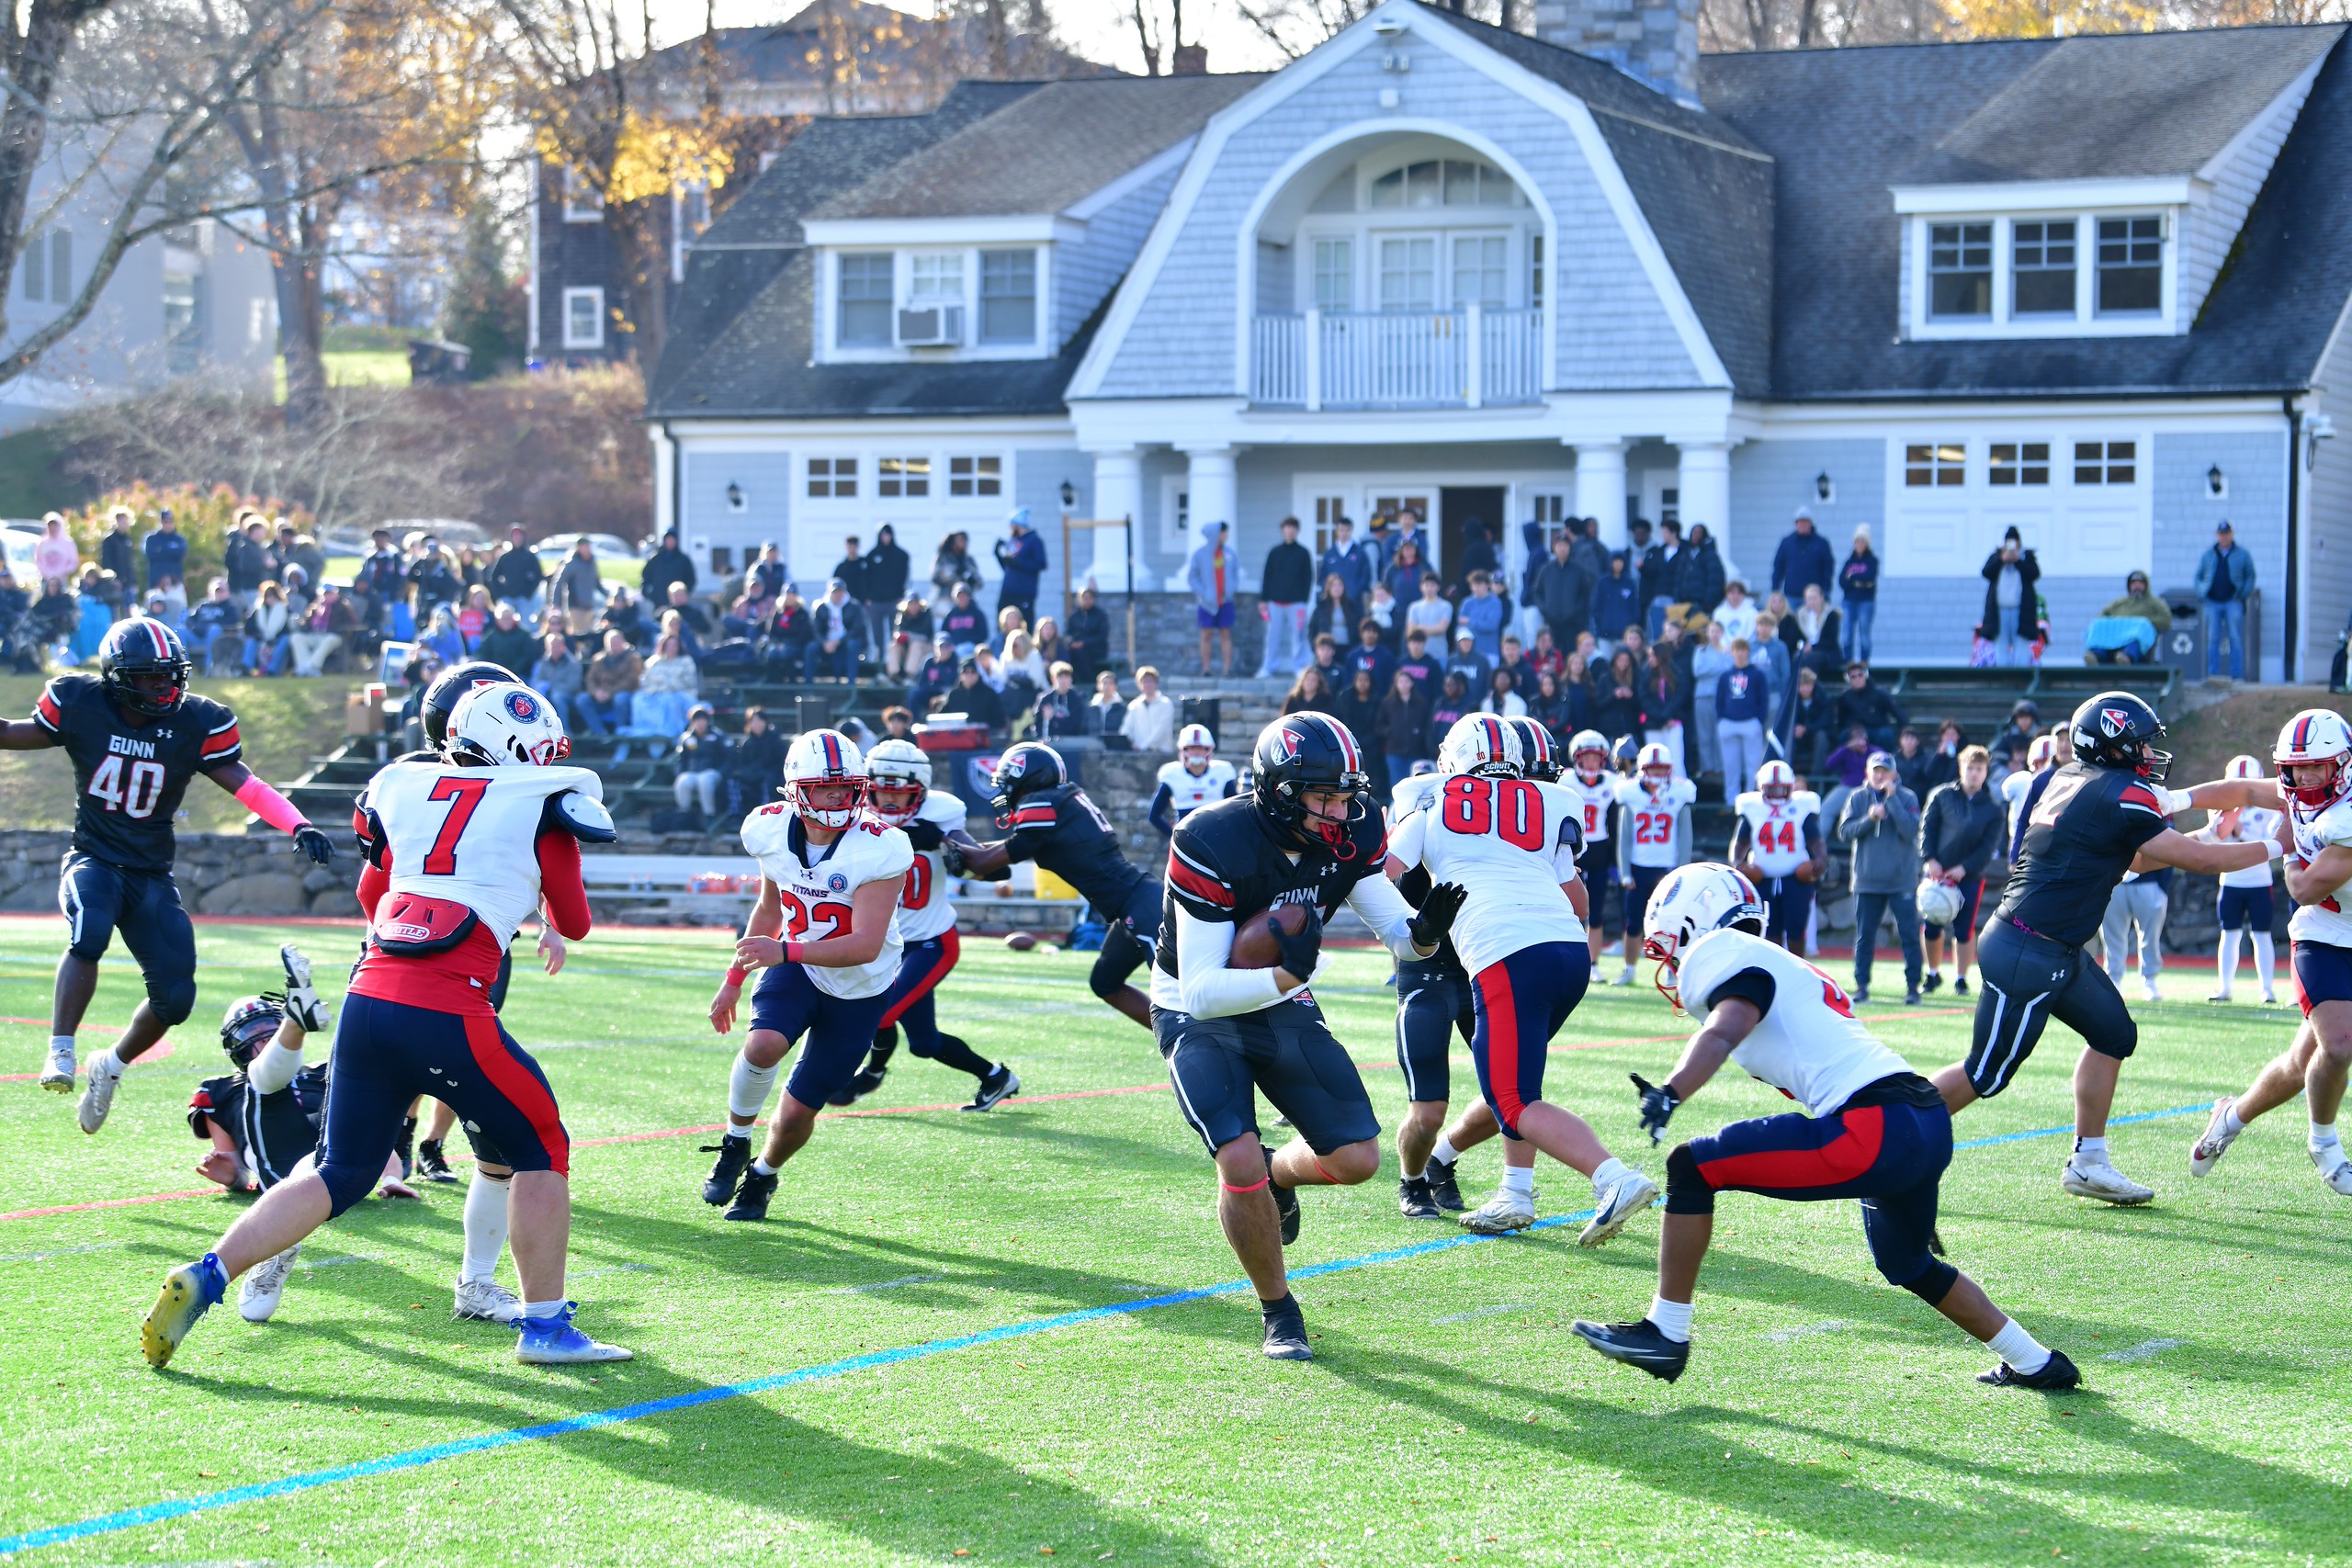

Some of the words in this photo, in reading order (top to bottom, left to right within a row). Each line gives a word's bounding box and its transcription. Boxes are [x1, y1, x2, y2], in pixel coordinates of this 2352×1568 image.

[108, 734, 155, 759] GUNN
[1476, 751, 1487, 761] 80
[1484, 761, 1511, 772] schutt
[88, 754, 165, 818] 40
[422, 775, 494, 876] 7
[1442, 773, 1545, 852] 80
[1635, 812, 1673, 844] 23
[1758, 820, 1796, 854] 44
[791, 882, 831, 898] TITANS
[1268, 884, 1320, 912] GUNN
[780, 889, 854, 942] 22
